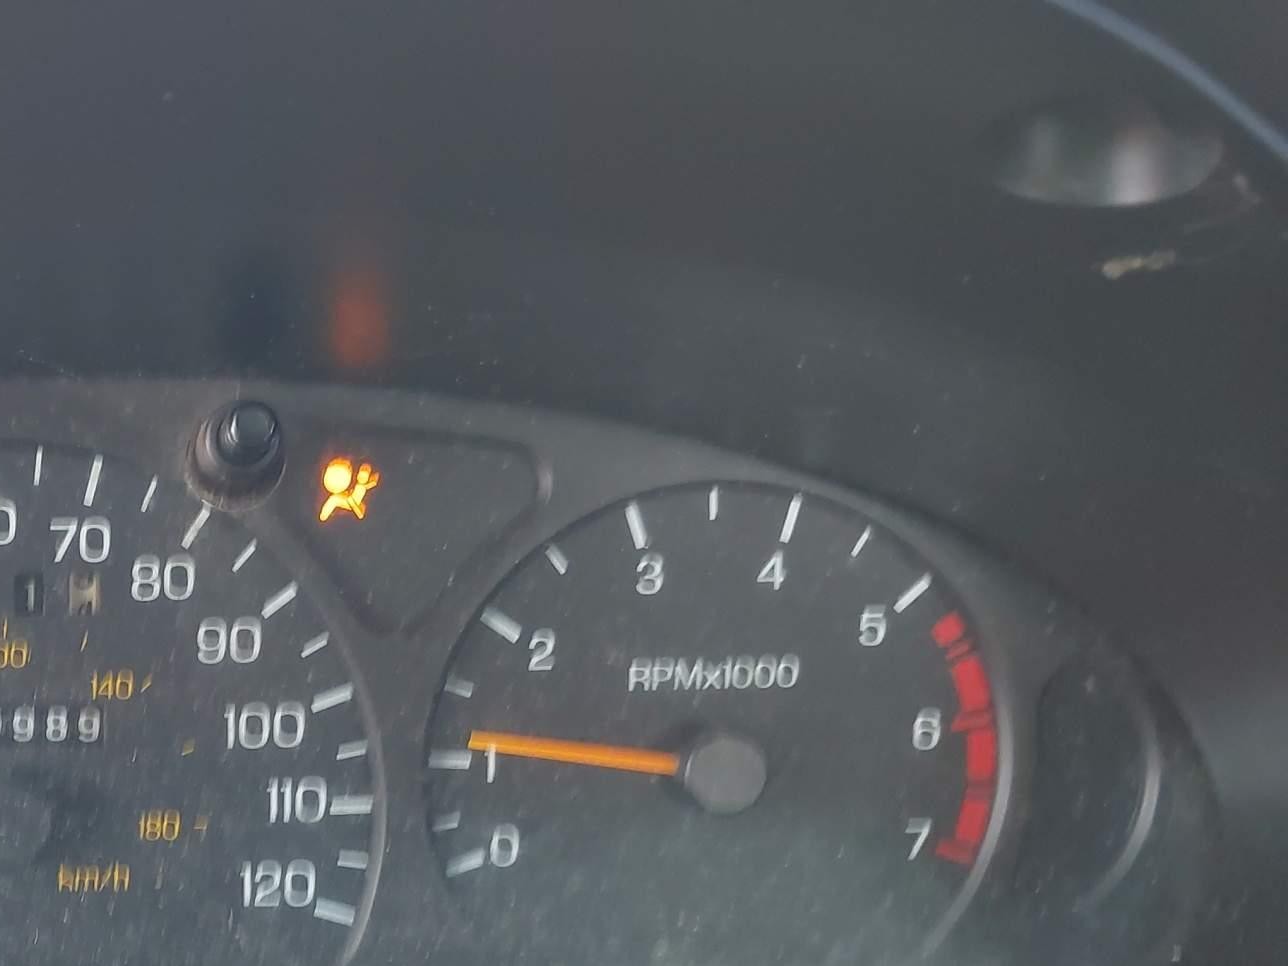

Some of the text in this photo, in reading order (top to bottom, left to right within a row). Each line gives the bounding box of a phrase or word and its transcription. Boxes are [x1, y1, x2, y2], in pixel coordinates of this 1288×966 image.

[50, 514, 112, 564] 70
[130, 553, 196, 602] 80
[635, 551, 665, 596] 3
[757, 550, 786, 591] 4
[196, 615, 263, 664] 90
[857, 604, 887, 647] 5
[527, 627, 557, 672] 2
[91, 668, 135, 700] 140
[627, 654, 801, 692] RPMx1000
[224, 702, 306, 749] 100
[912, 707, 942, 751] 6
[484, 743, 496, 783] 1
[267, 776, 328, 824] 110
[139, 809, 182, 841] 180
[489, 823, 521, 868] 0
[905, 816, 933, 861] 7
[58, 861, 130, 893] km/h
[241, 858, 317, 908] 120
